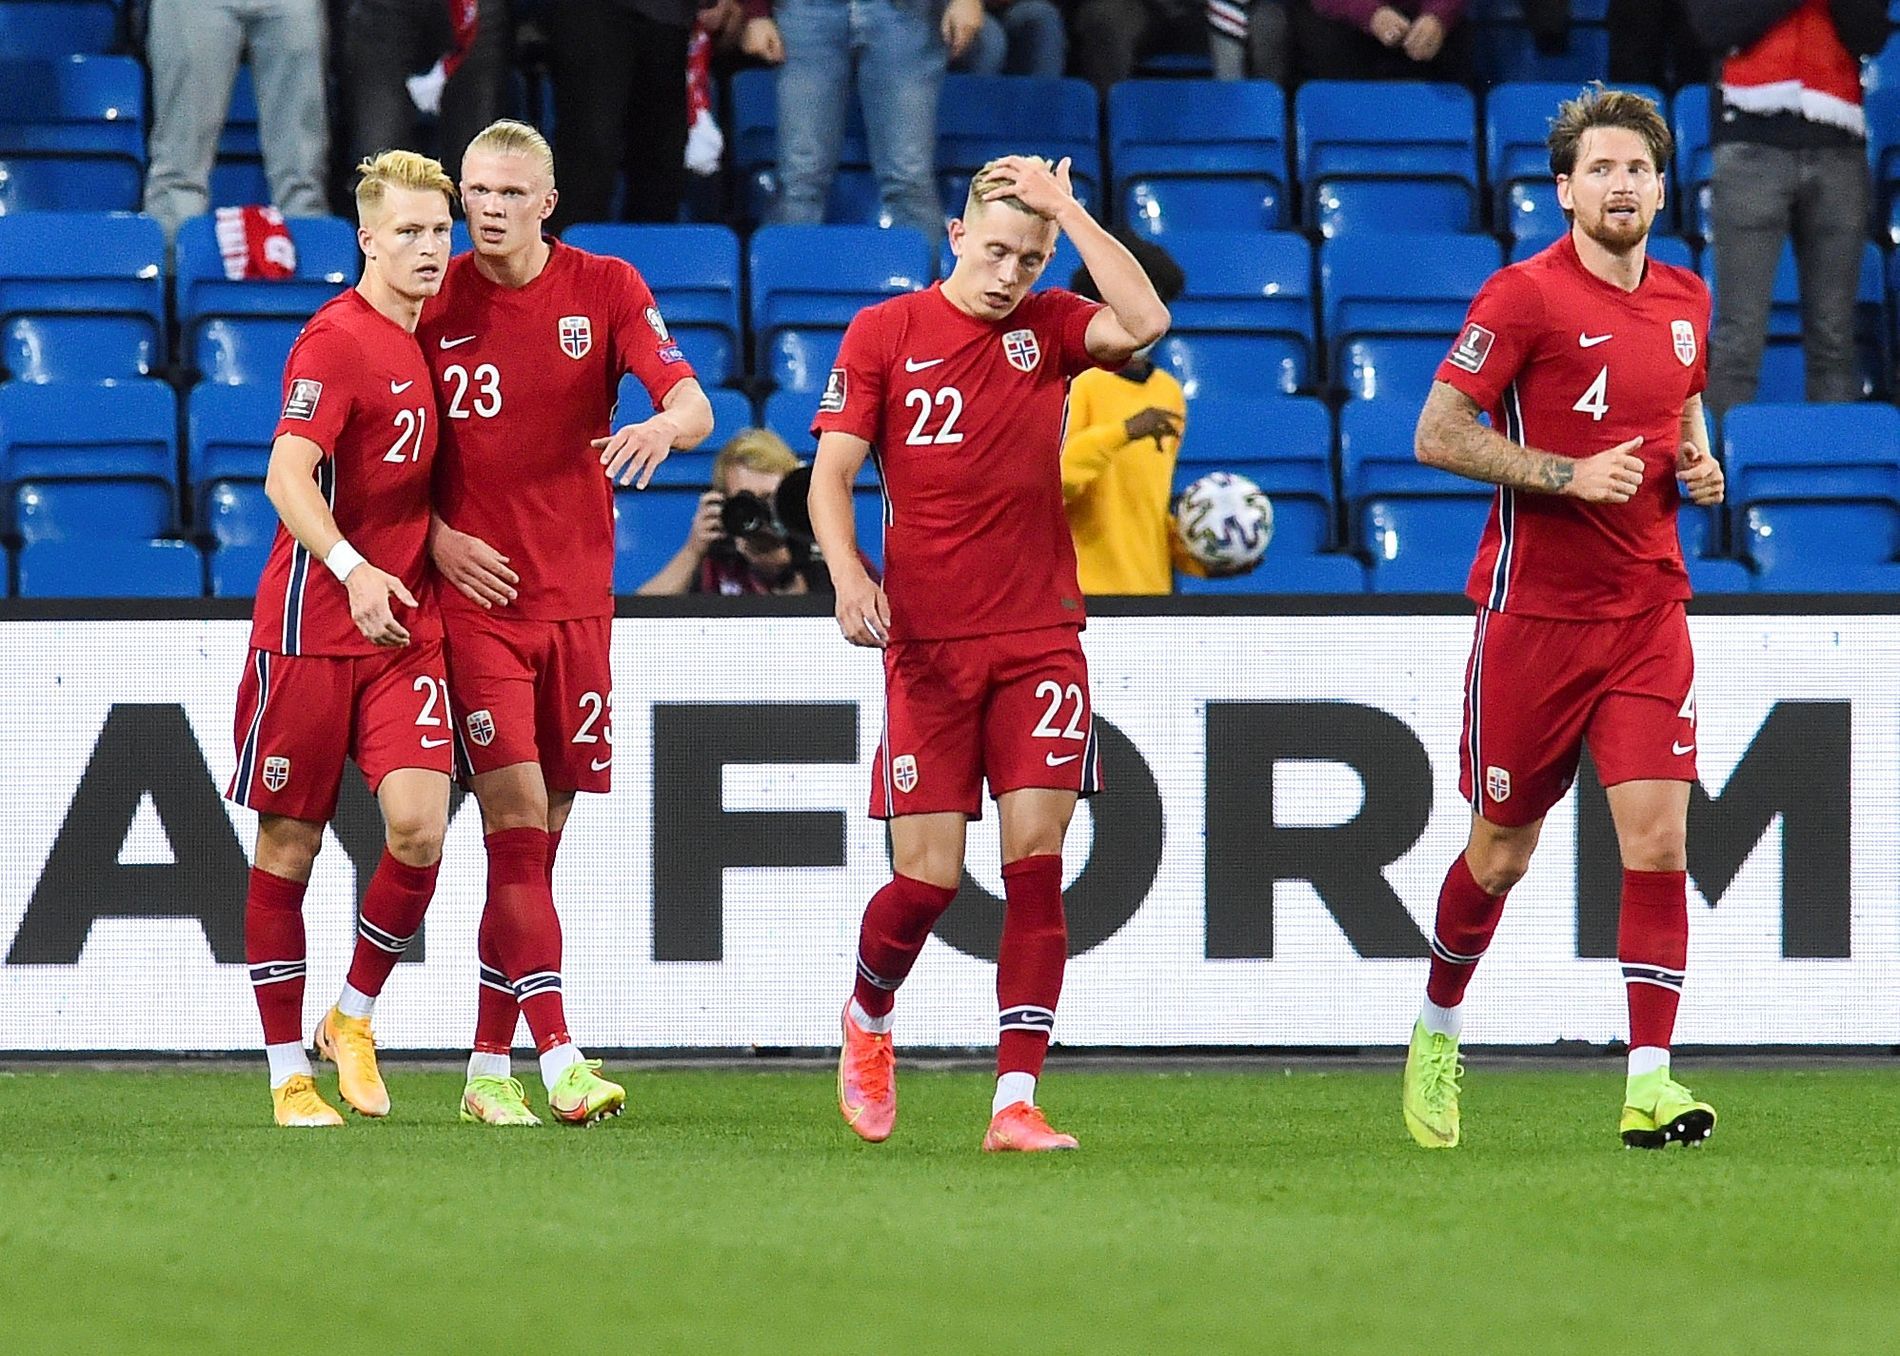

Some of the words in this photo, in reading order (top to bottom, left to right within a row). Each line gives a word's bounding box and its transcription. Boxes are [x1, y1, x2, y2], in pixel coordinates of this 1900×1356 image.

[443, 363, 503, 418] 23
[905, 386, 964, 446] 22
[1571, 364, 1610, 421] 4
[382, 407, 426, 463] 21
[413, 675, 453, 731] 21
[1031, 680, 1086, 740] 22
[1677, 680, 1696, 729] 4
[6, 702, 473, 966] A
